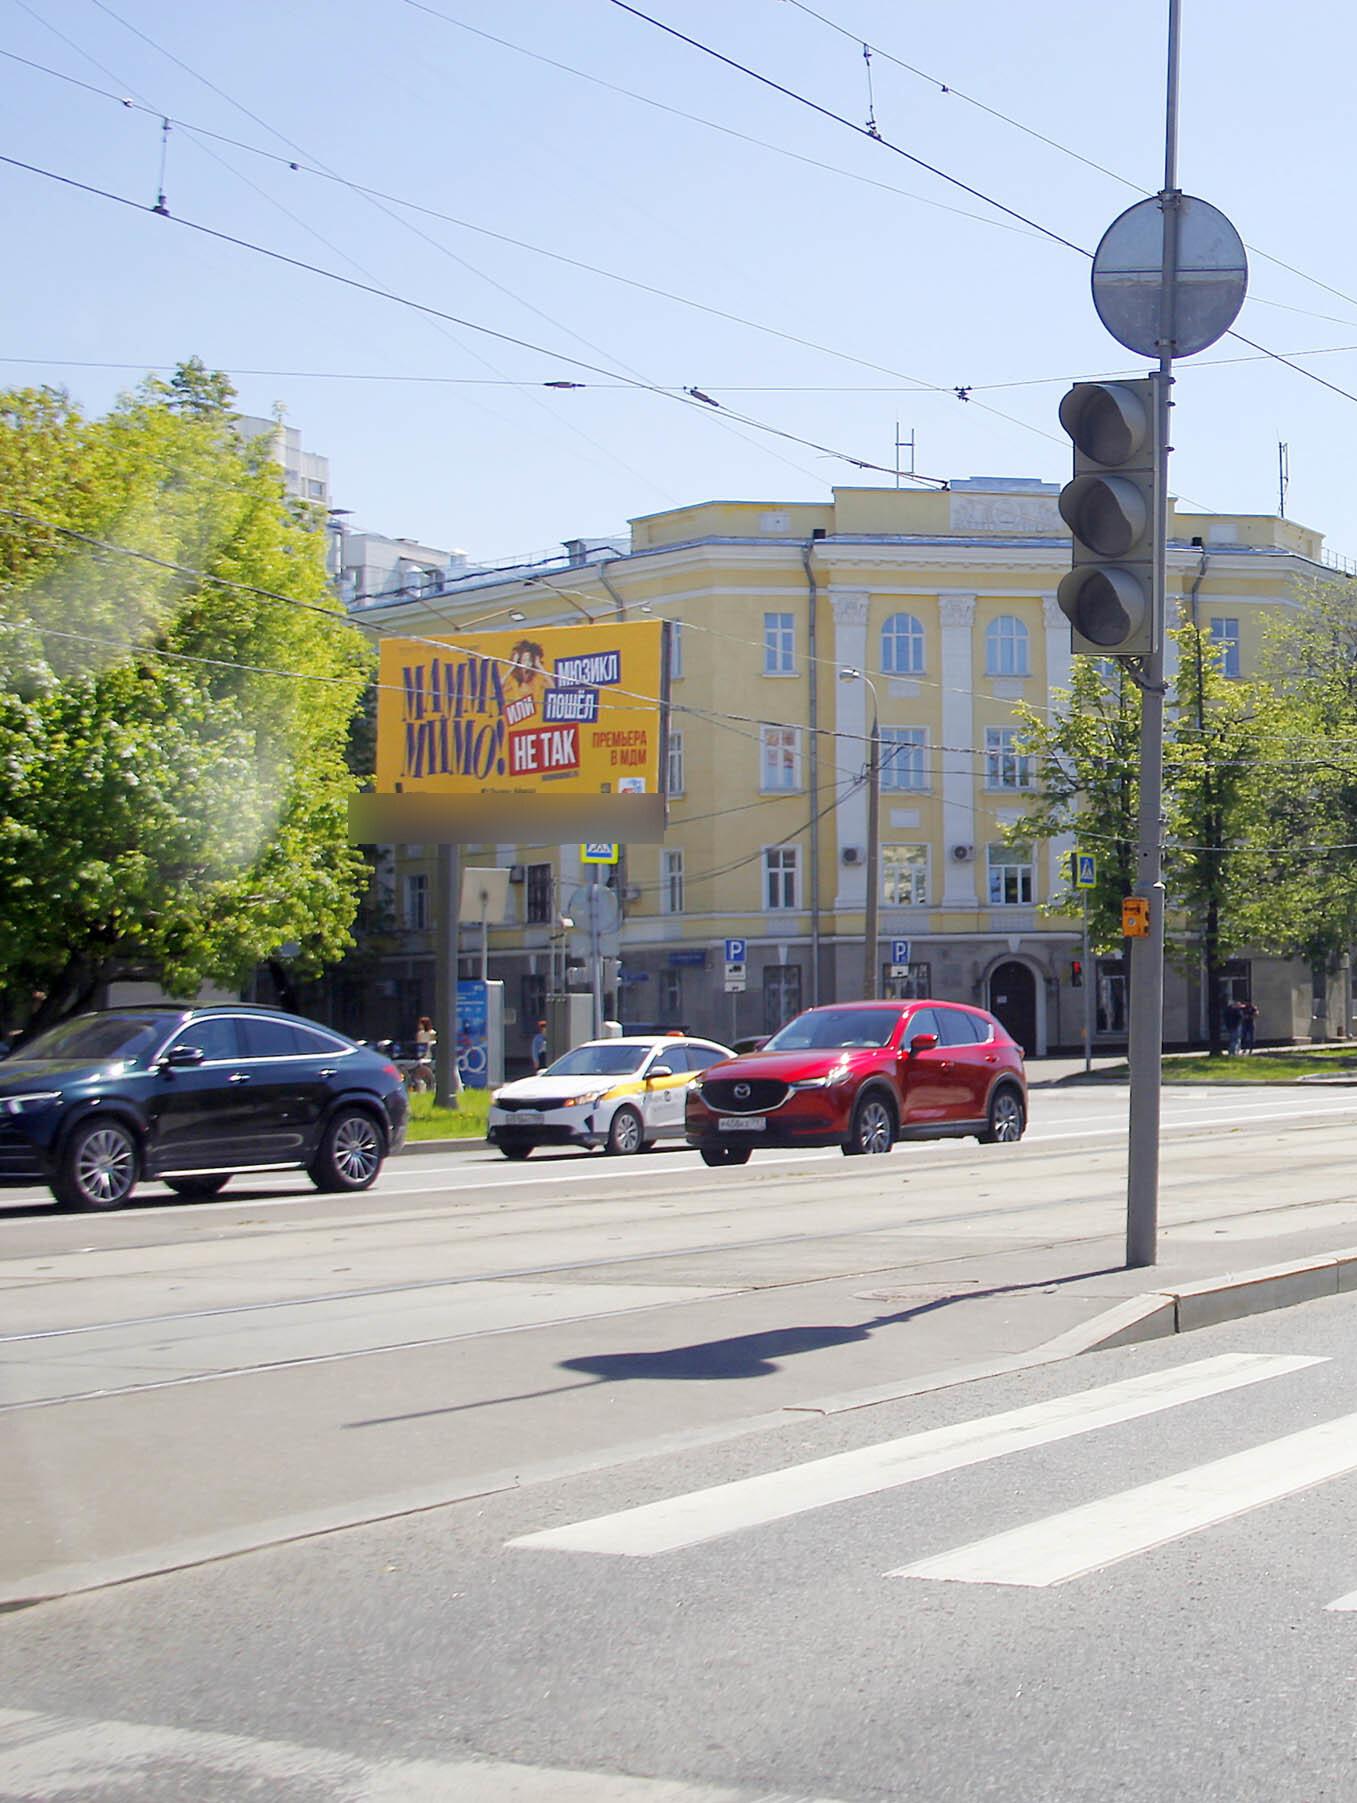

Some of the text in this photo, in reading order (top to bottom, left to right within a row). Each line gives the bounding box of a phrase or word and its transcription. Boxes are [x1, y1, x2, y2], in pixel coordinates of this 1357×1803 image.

[558, 654, 618, 686] МЮЗИКЛ
[401, 657, 505, 722] МАММА
[545, 689, 595, 720] ПОШЁЛ
[506, 695, 535, 725] ИЛИ
[514, 728, 577, 771] НЕ ТАК
[592, 730, 648, 749] ПРЕМЬЕРА
[610, 749, 647, 766] В МДМ
